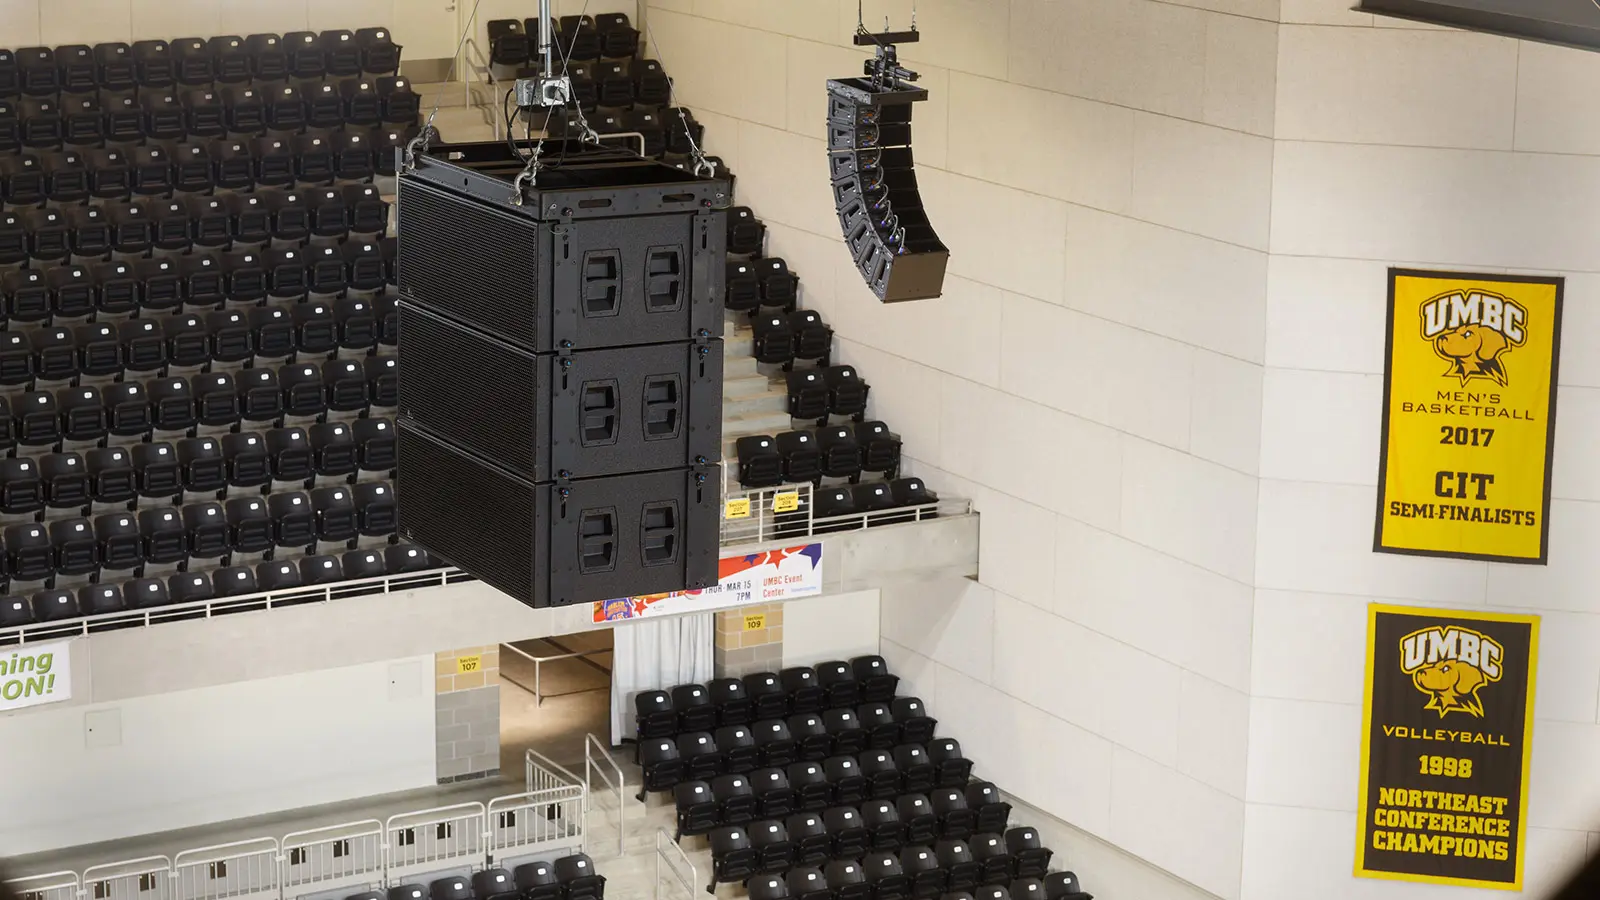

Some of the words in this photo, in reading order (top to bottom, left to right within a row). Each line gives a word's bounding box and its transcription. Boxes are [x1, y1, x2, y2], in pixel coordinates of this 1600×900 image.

[1422, 291, 1526, 344] UMBC
[1437, 390, 1501, 404] MEN'S
[1402, 402, 1535, 421] BASKETBALL
[1440, 426, 1495, 447] 2017
[1435, 471, 1495, 500] CIT
[1390, 501, 1536, 527] SEMI-FINALISTS
[726, 581, 742, 591] MAR
[744, 580, 752, 589] 15
[763, 576, 782, 587] UMBC
[784, 574, 803, 584] Event
[736, 591, 751, 601] 7PM
[763, 588, 785, 598] Center
[748, 620, 761, 629] 109
[1402, 628, 1502, 679] UMBC
[463, 663, 476, 671] 107
[0, 674, 55, 700] ON!
[1383, 724, 1510, 746] VOLLEYBALL
[1418, 754, 1473, 778] 1998
[1379, 787, 1508, 815] NORTHEAST
[1374, 808, 1510, 837] CONFERENCE
[1372, 830, 1509, 861] CHAMPIONS
